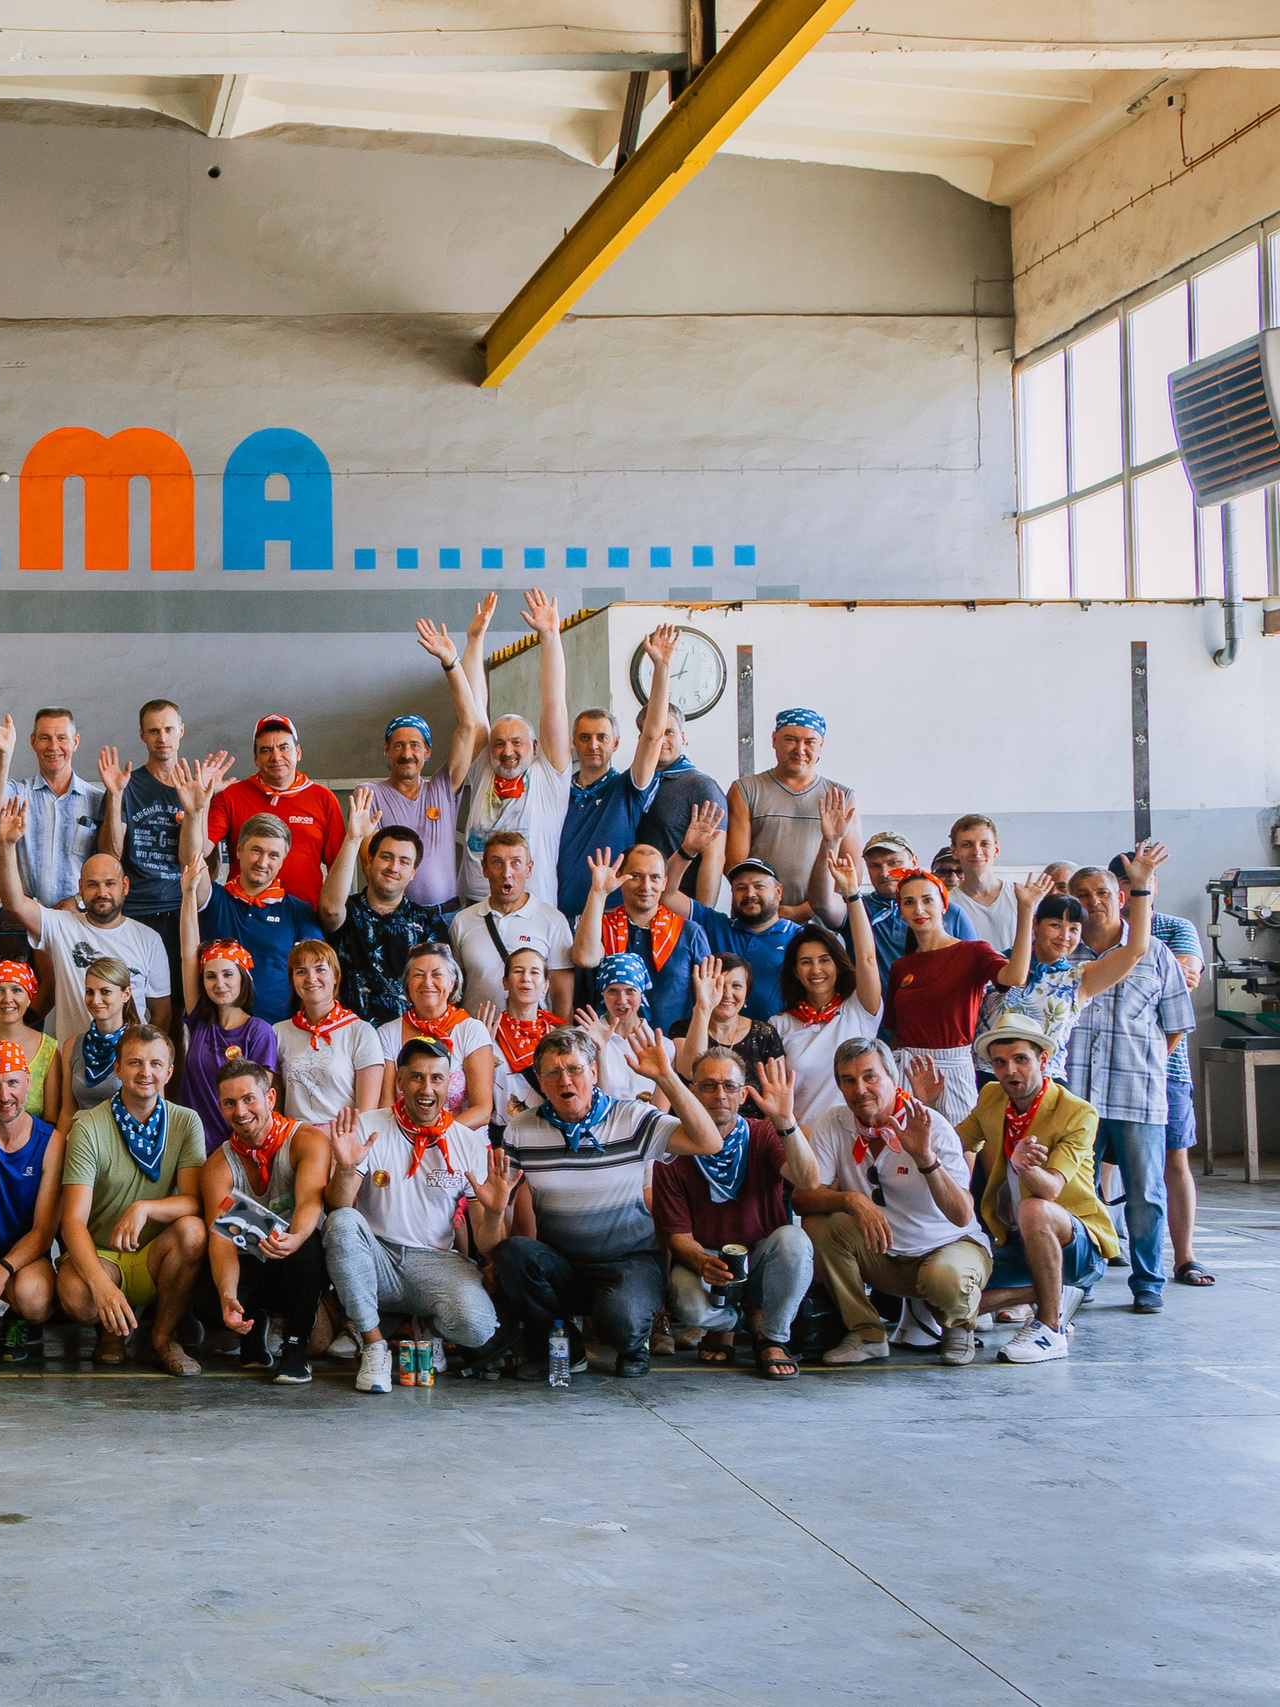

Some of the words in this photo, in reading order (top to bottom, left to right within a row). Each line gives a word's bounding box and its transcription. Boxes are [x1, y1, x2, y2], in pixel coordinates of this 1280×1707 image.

[132, 805, 164, 822] ORIGINAL
[166, 805, 184, 814] JEA
[426, 1169, 462, 1178] STAR
[426, 1177, 462, 1188] WARS
